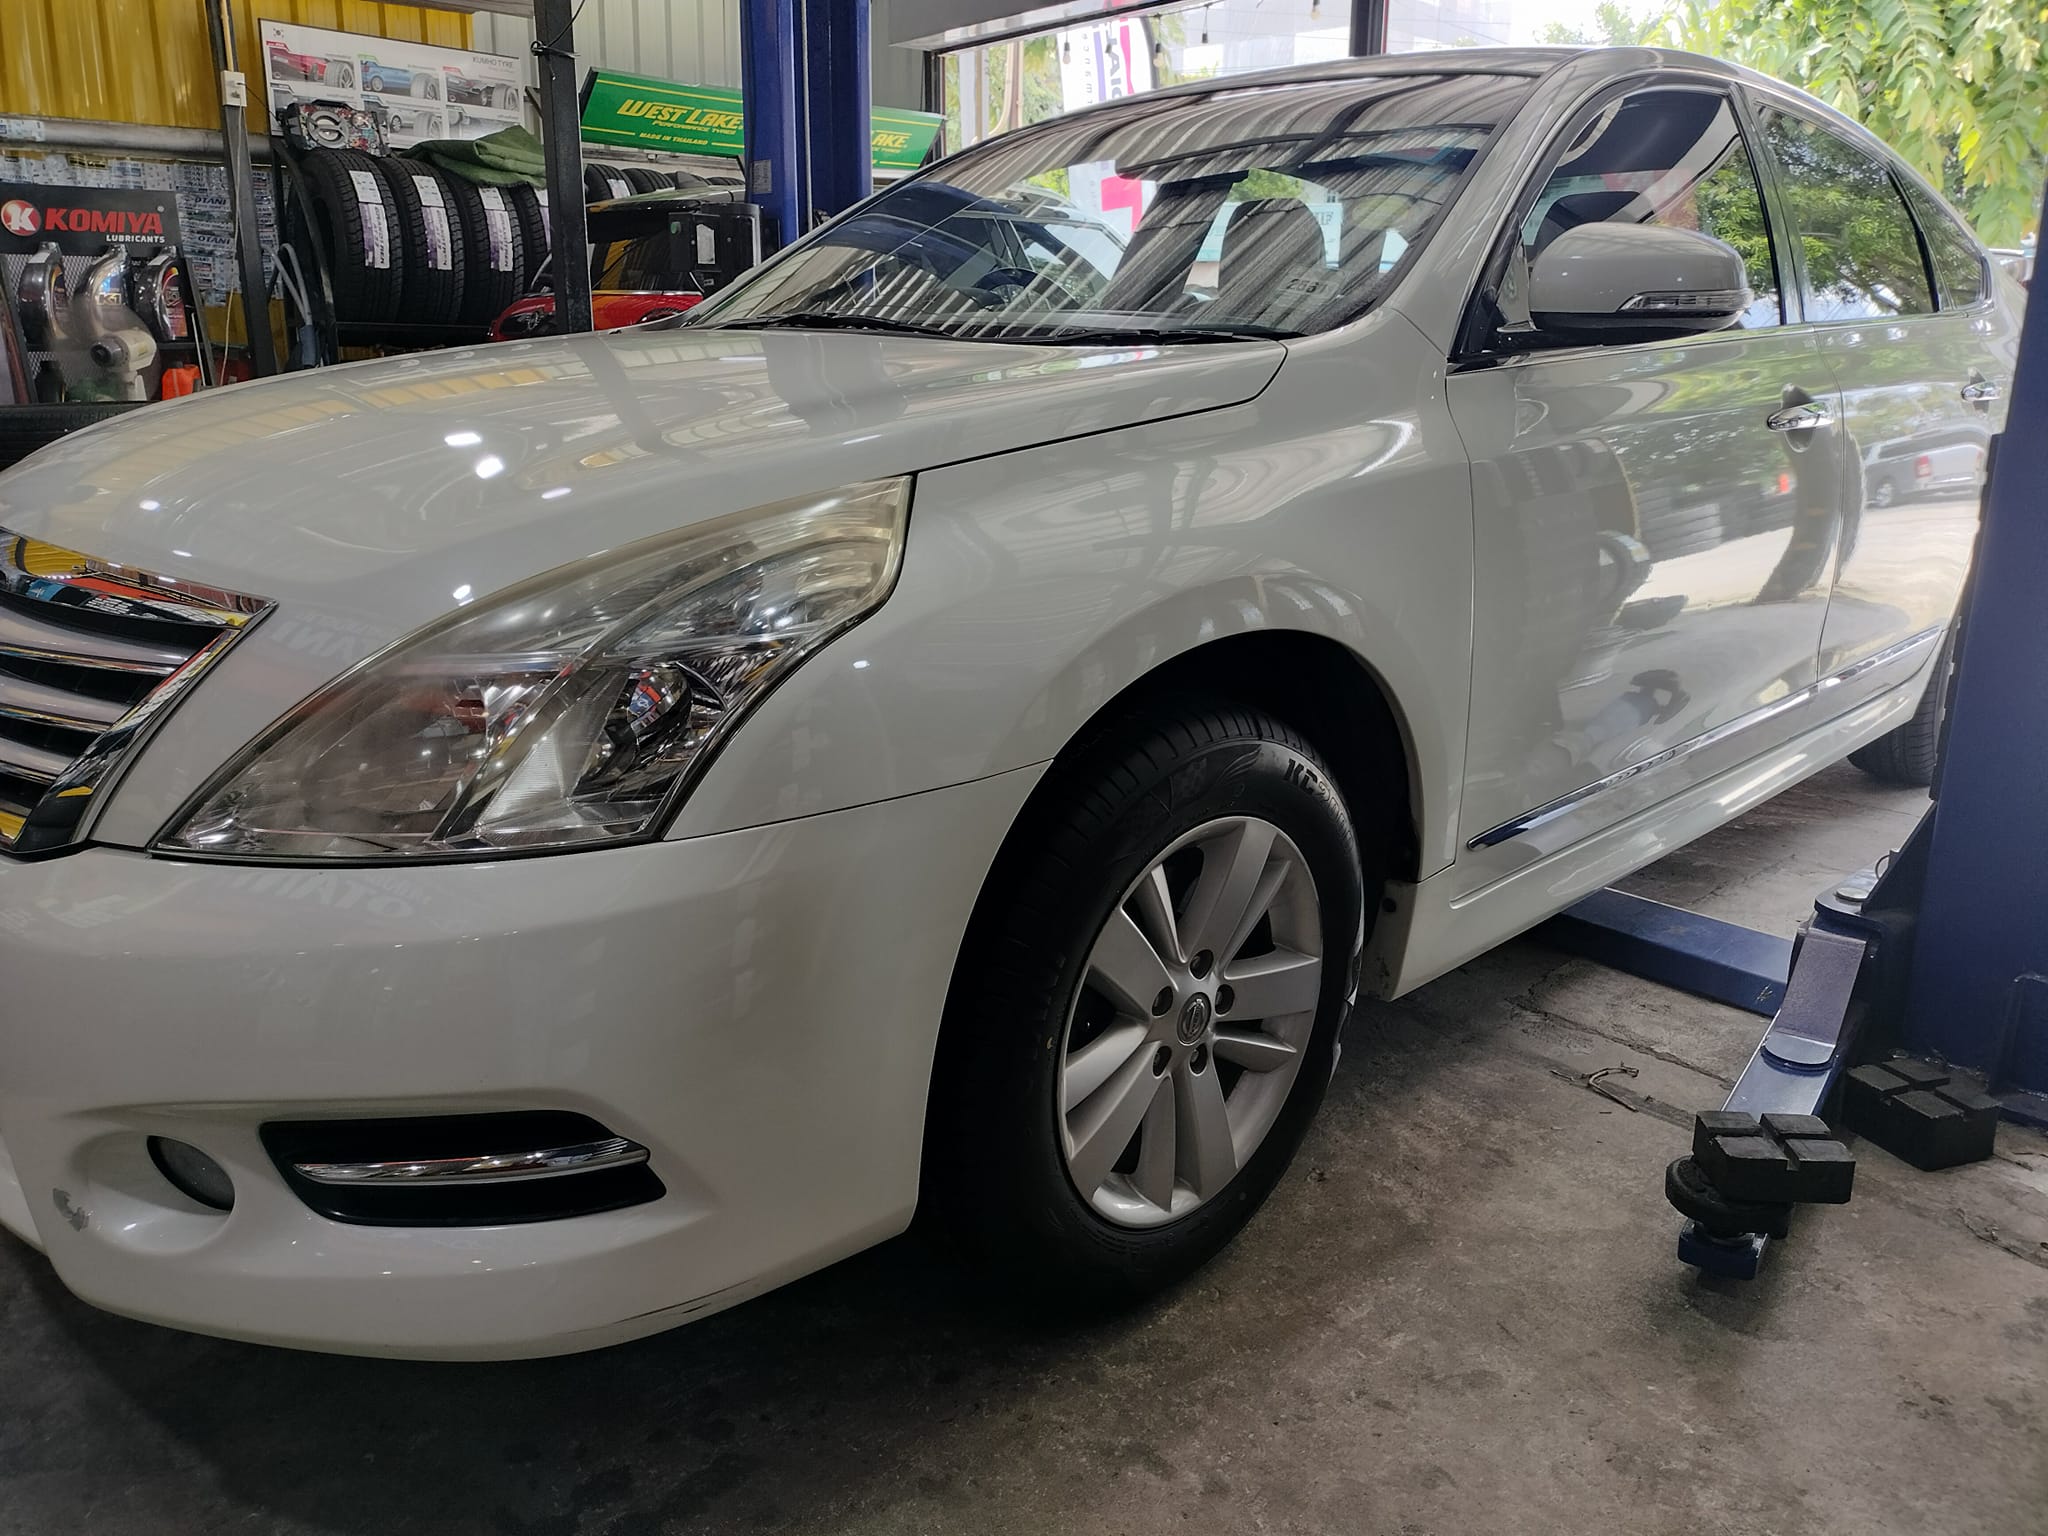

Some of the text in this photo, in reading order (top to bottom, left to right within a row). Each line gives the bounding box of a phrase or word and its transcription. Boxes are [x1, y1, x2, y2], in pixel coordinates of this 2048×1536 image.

[472, 56, 514, 68] KUMHO TYRE
[617, 99, 743, 130] WEST LAKE
[652, 120, 710, 132] PERFORMANCE
[639, 132, 661, 140] MADE
[673, 136, 709, 145] THAILAND
[872, 131, 910, 148] AKE
[195, 196, 227, 205] OTANI
[45, 207, 164, 235] KOMIYA
[105, 234, 166, 244] LUBRICANTS
[198, 235, 231, 245] OTANI
